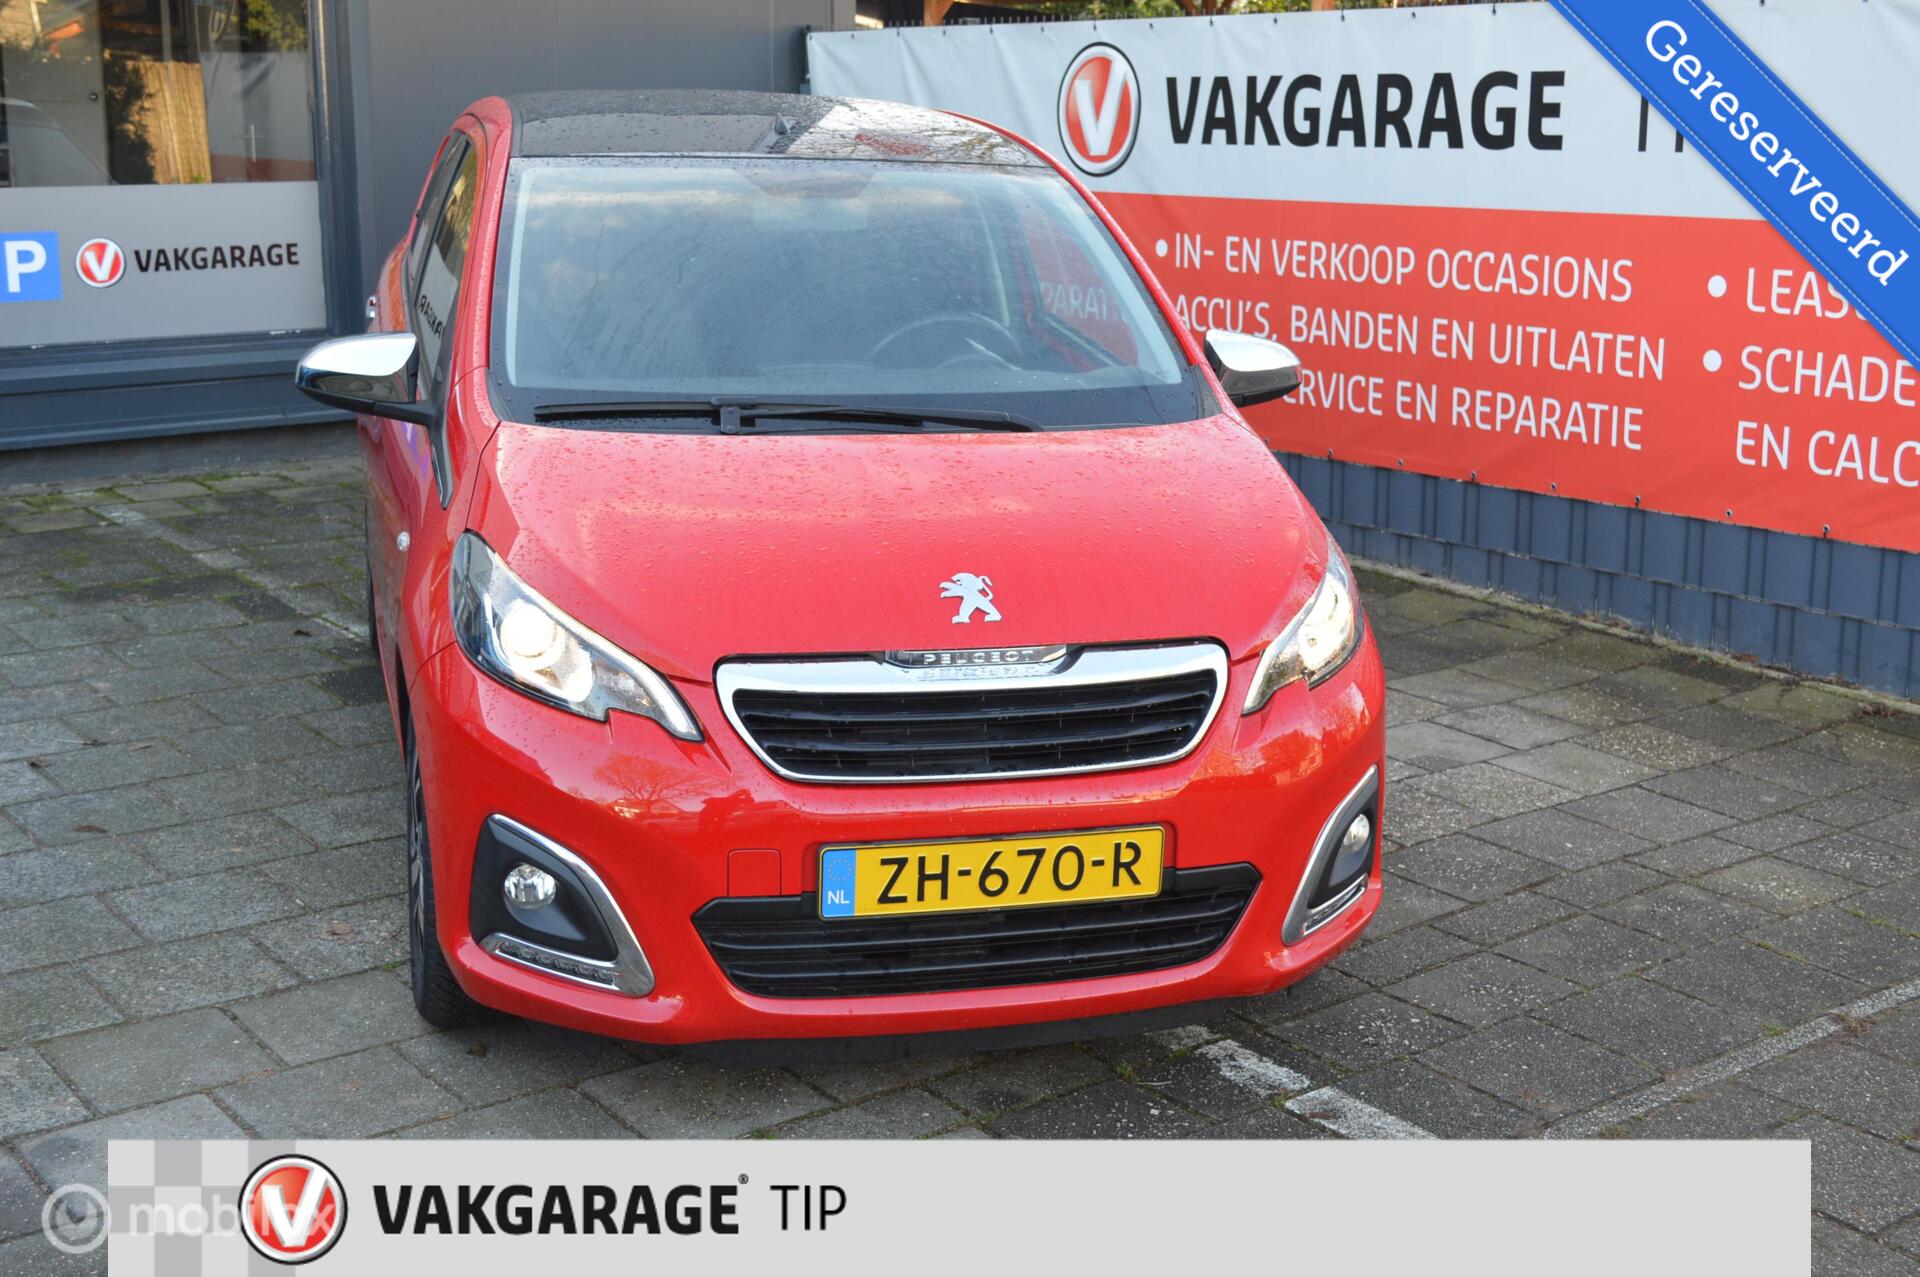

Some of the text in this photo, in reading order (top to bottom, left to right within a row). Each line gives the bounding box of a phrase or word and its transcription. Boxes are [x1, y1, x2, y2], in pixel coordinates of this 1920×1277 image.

[1166, 70, 1566, 151] VAKGARAGE
[4, 240, 47, 293] P
[134, 243, 300, 273] VAKGARAGE
[1174, 232, 1633, 303] IN- EN VERKOOP OCCASIONS
[1746, 266, 1868, 321] LEAS
[1290, 304, 1419, 355] BANDEN
[1431, 317, 1474, 361] EN
[1489, 323, 1665, 381] UITLATEN
[1738, 345, 1917, 407] SCHADE
[1396, 380, 1438, 423] EN
[1452, 386, 1643, 451] REPARATIE
[1736, 420, 1790, 470] EN
[827, 841, 1142, 905] NL ZH-670-R
